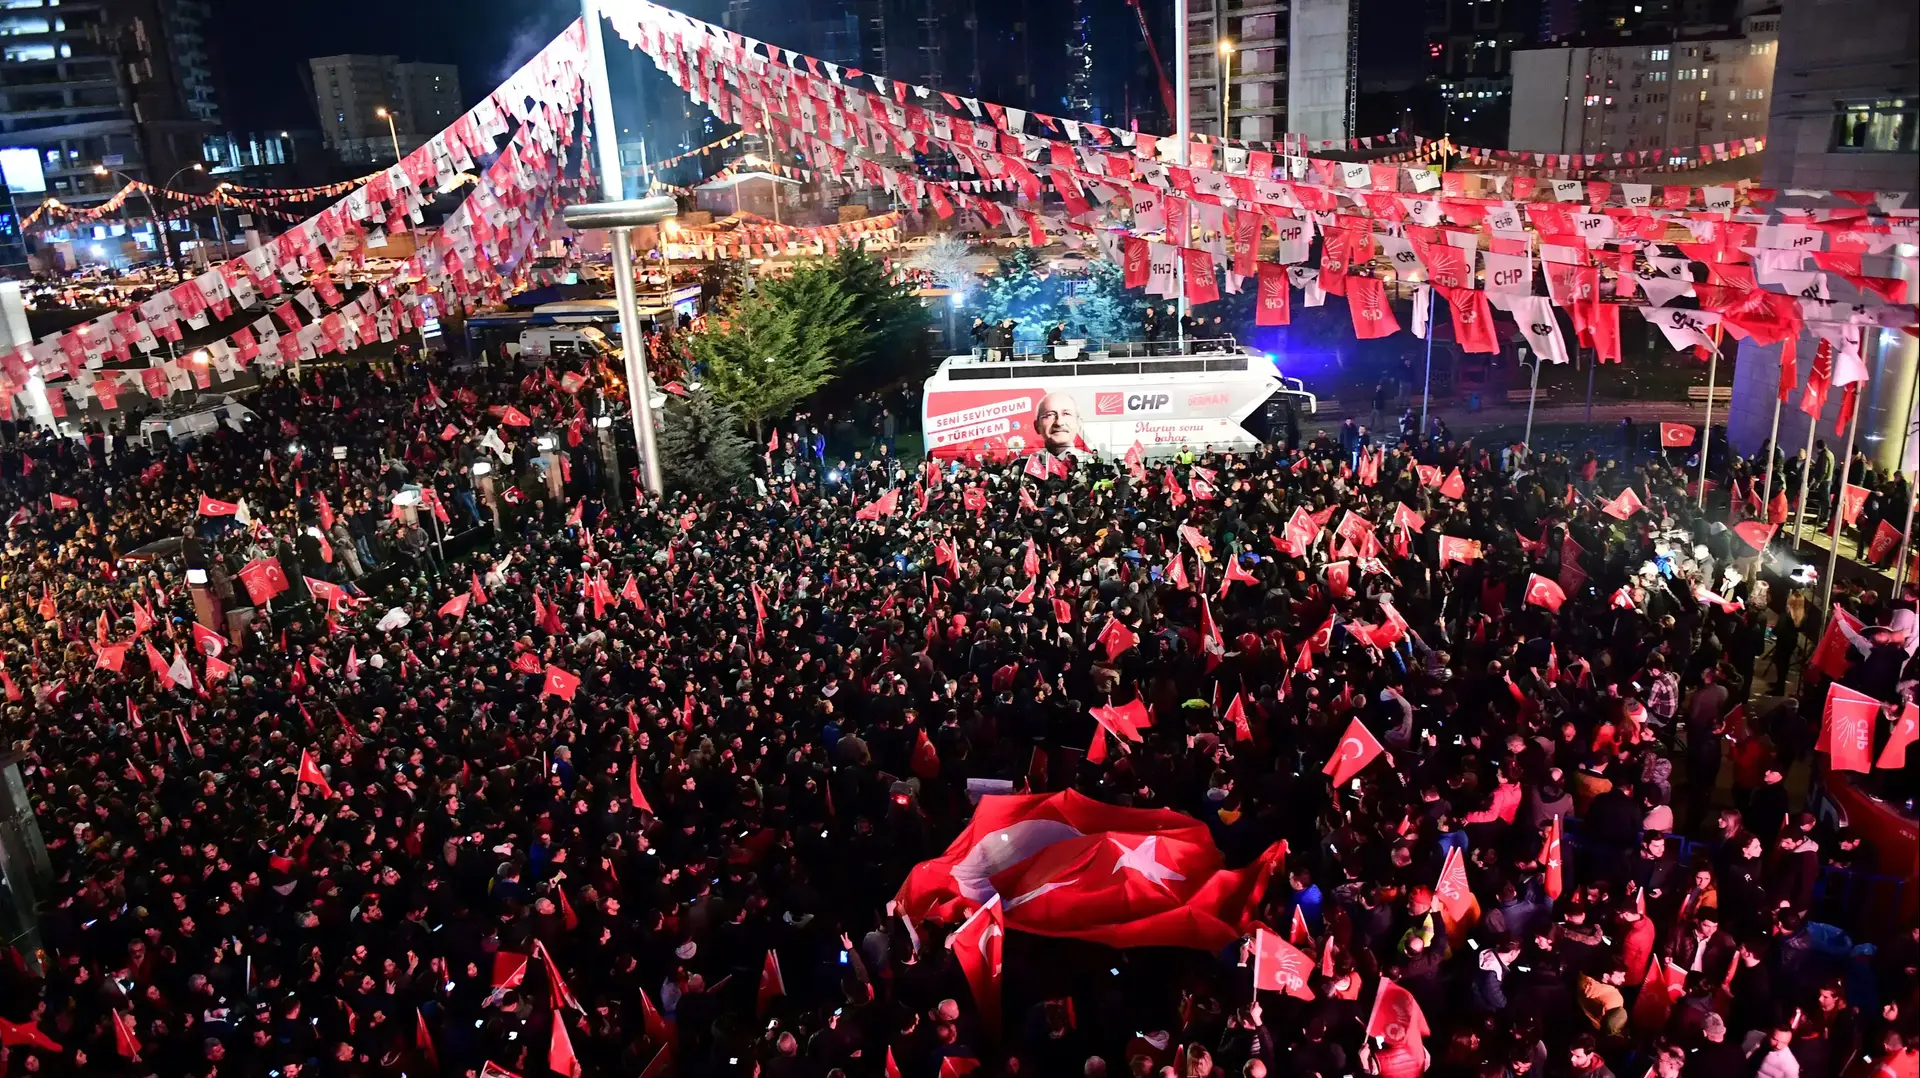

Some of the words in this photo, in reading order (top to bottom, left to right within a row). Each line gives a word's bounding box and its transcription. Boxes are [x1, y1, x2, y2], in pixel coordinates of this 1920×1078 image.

[1348, 168, 1363, 178] CHP
[1416, 170, 1430, 181] CHP
[1558, 182, 1576, 190] CHP
[1134, 200, 1153, 214] CHP
[1495, 218, 1512, 228] CHP
[1580, 218, 1600, 230] HP
[1280, 226, 1302, 242] CHP
[1234, 242, 1250, 254] CHP
[1396, 252, 1416, 262] CHP
[1320, 256, 1342, 272] CHP
[1434, 275, 1459, 288] CHP
[1494, 268, 1522, 286] CHP
[163, 304, 175, 312] CHP
[147, 314, 160, 322] CHP
[95, 336, 108, 344] CHP
[40, 358, 52, 366] CHP
[219, 354, 230, 362] CHP
[1128, 394, 1170, 410] CHP
[936, 415, 960, 428] SENİ
[962, 401, 1026, 422] SEVİYORUM
[948, 422, 1004, 442] TÜRKİYEM
[1342, 528, 1356, 539] CHP
[1448, 550, 1464, 558] CHP
[246, 580, 258, 594] CHP
[1274, 970, 1304, 992] CHP
